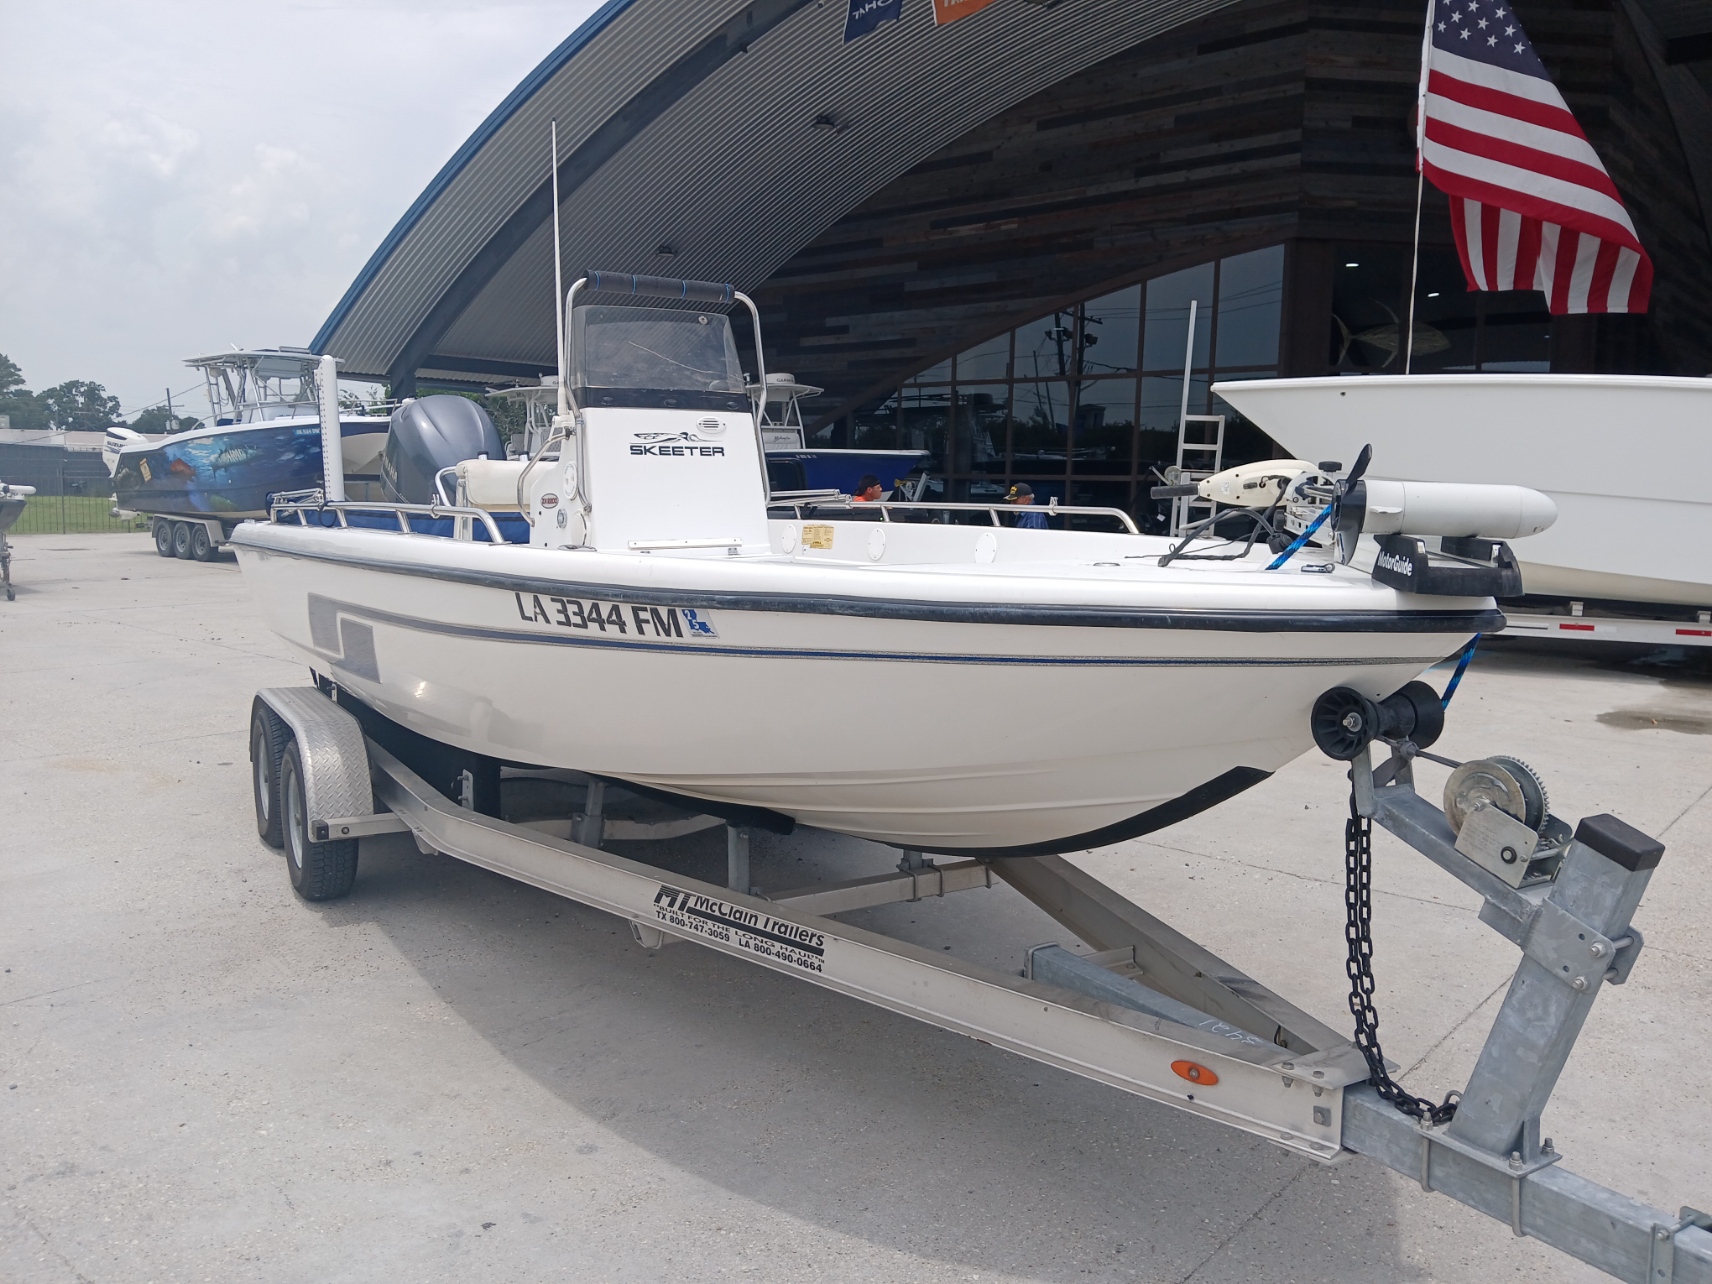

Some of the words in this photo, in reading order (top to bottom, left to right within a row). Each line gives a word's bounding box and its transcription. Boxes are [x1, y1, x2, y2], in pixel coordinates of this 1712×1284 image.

[629, 445, 725, 457] SKEETER
[1377, 550, 1413, 576] MotorGuide
[515, 592, 551, 625] LA
[550, 597, 628, 635] 3344
[631, 605, 684, 638] FM
[655, 910, 667, 921] TX
[738, 937, 751, 950] LA
[687, 915, 709, 926] FOR
[711, 922, 731, 933] THE
[734, 930, 776, 948] LONG
[693, 896, 759, 926] McClain
[763, 916, 825, 947] Trailers
